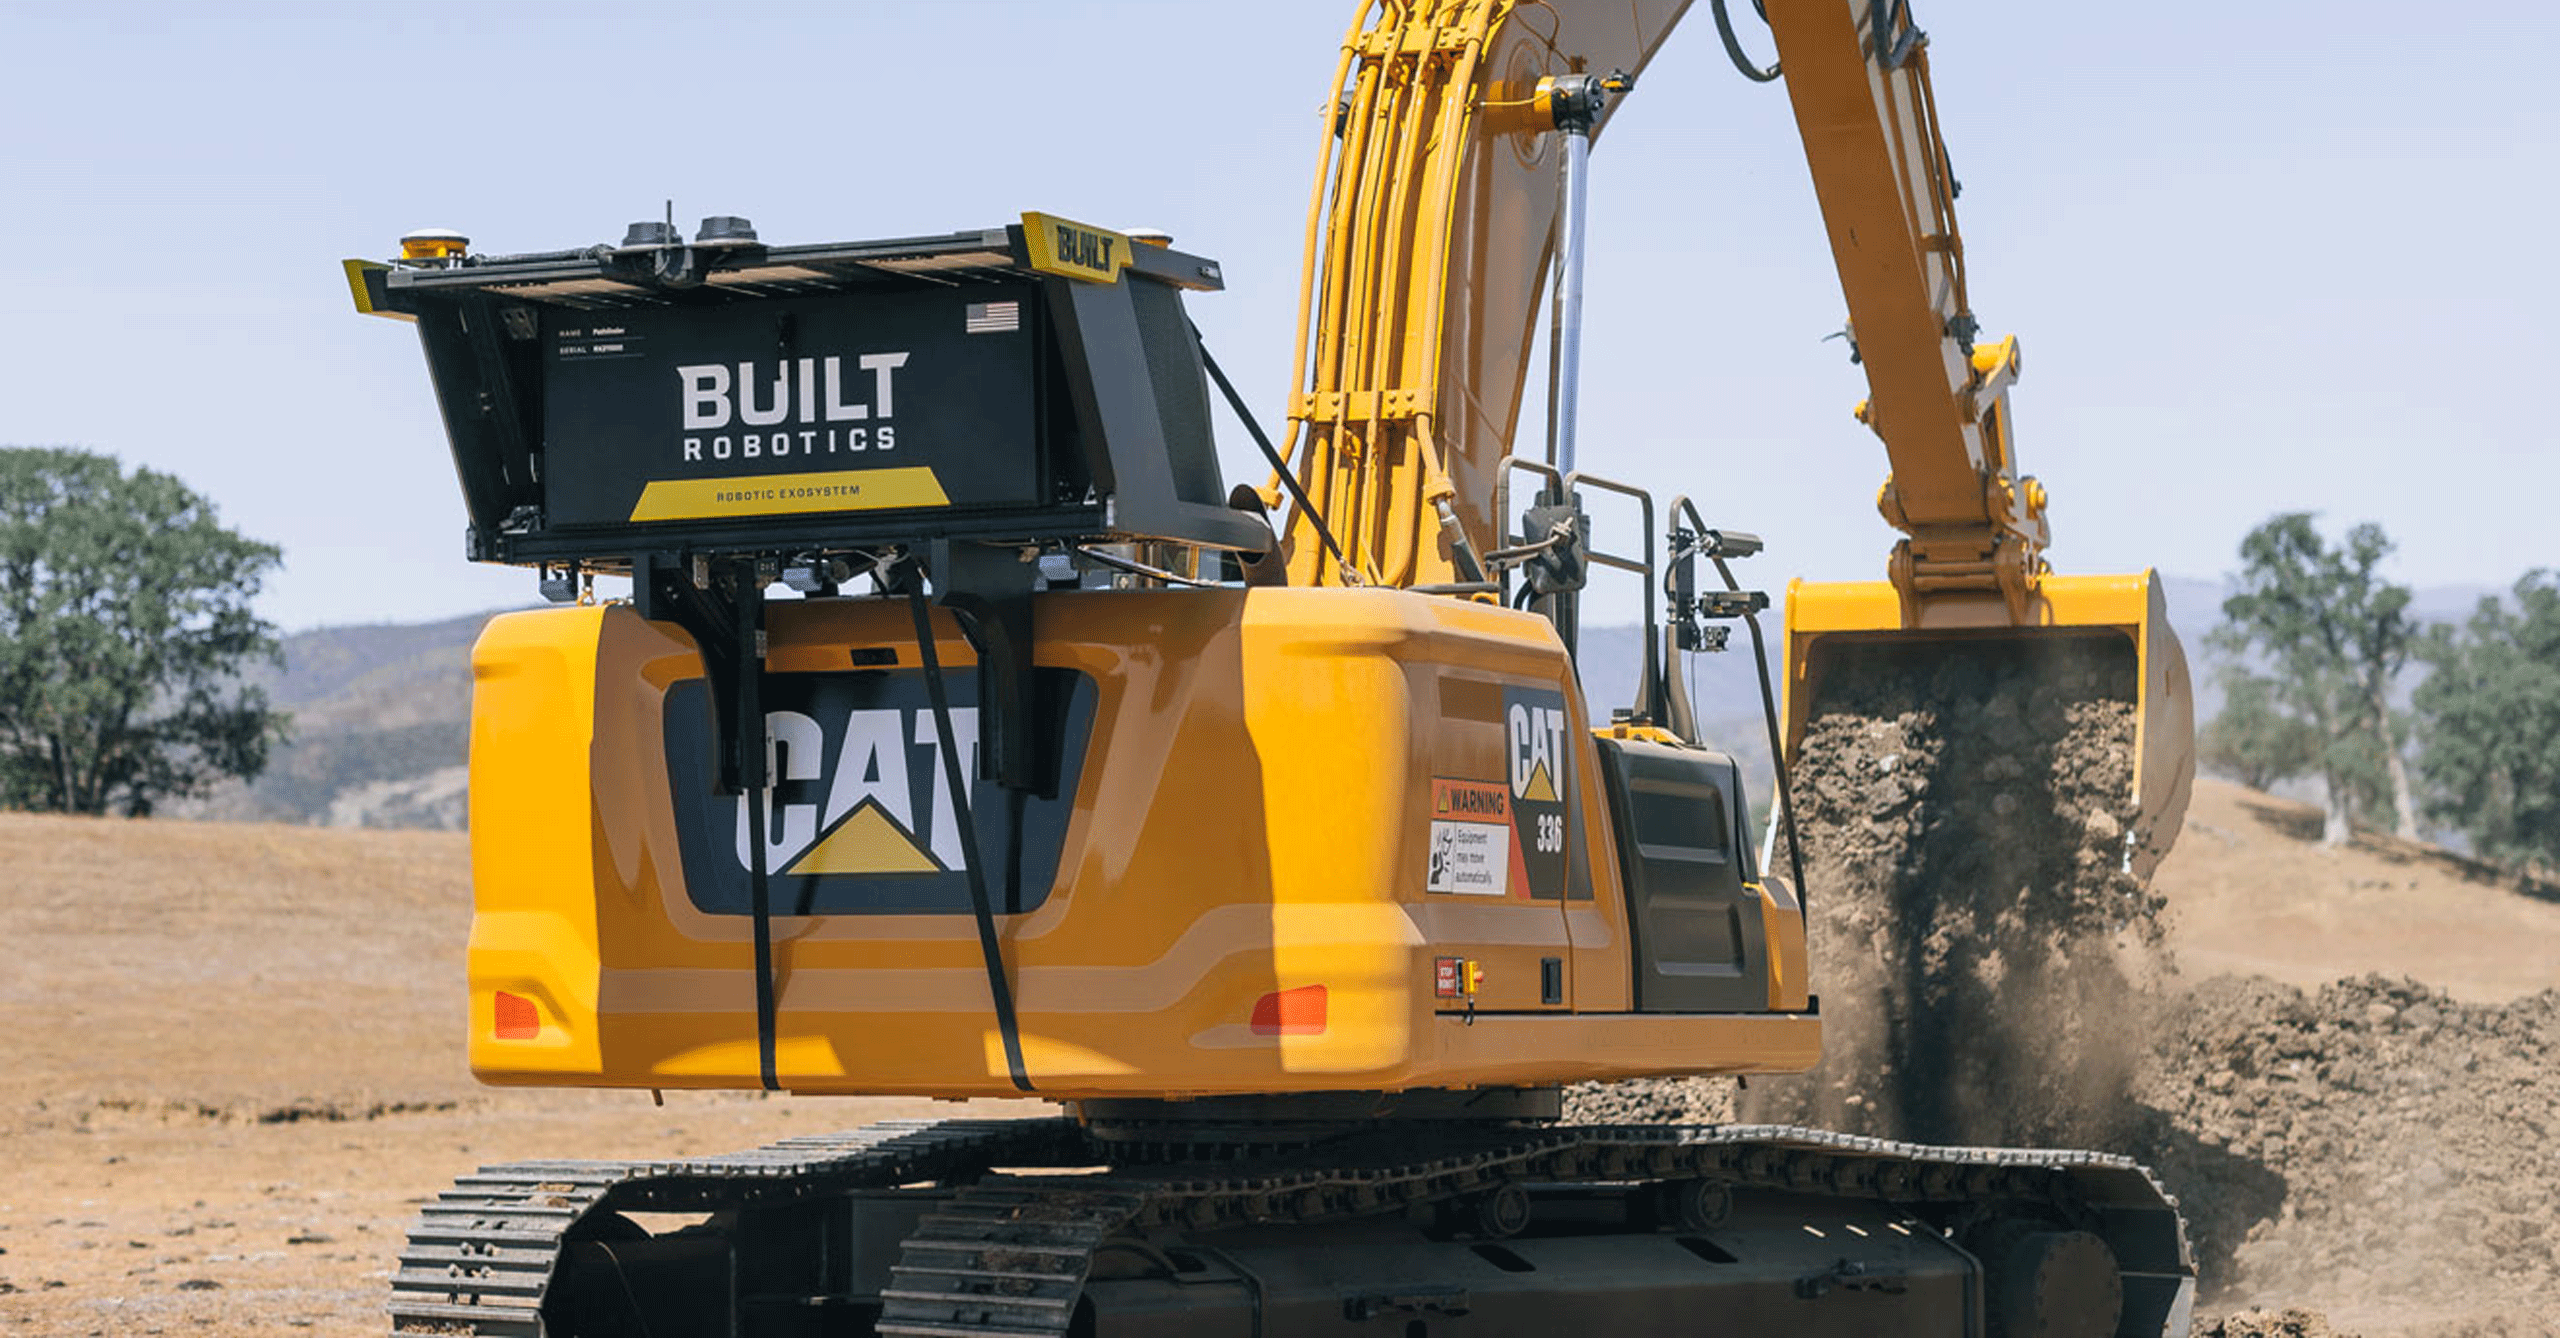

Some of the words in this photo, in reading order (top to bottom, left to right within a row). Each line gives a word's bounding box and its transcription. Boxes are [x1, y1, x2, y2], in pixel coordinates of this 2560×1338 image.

[1057, 225, 1114, 272] BUILT
[676, 352, 910, 430] BUILT
[684, 427, 895, 461] ROBOTICS
[716, 489, 775, 503] ROBOTIC
[779, 485, 861, 499] EXOSYSTEM
[1509, 703, 1564, 802] CAT
[736, 707, 980, 875] CAT
[1450, 787, 1504, 815] WARNING
[1537, 814, 1562, 853] 336
